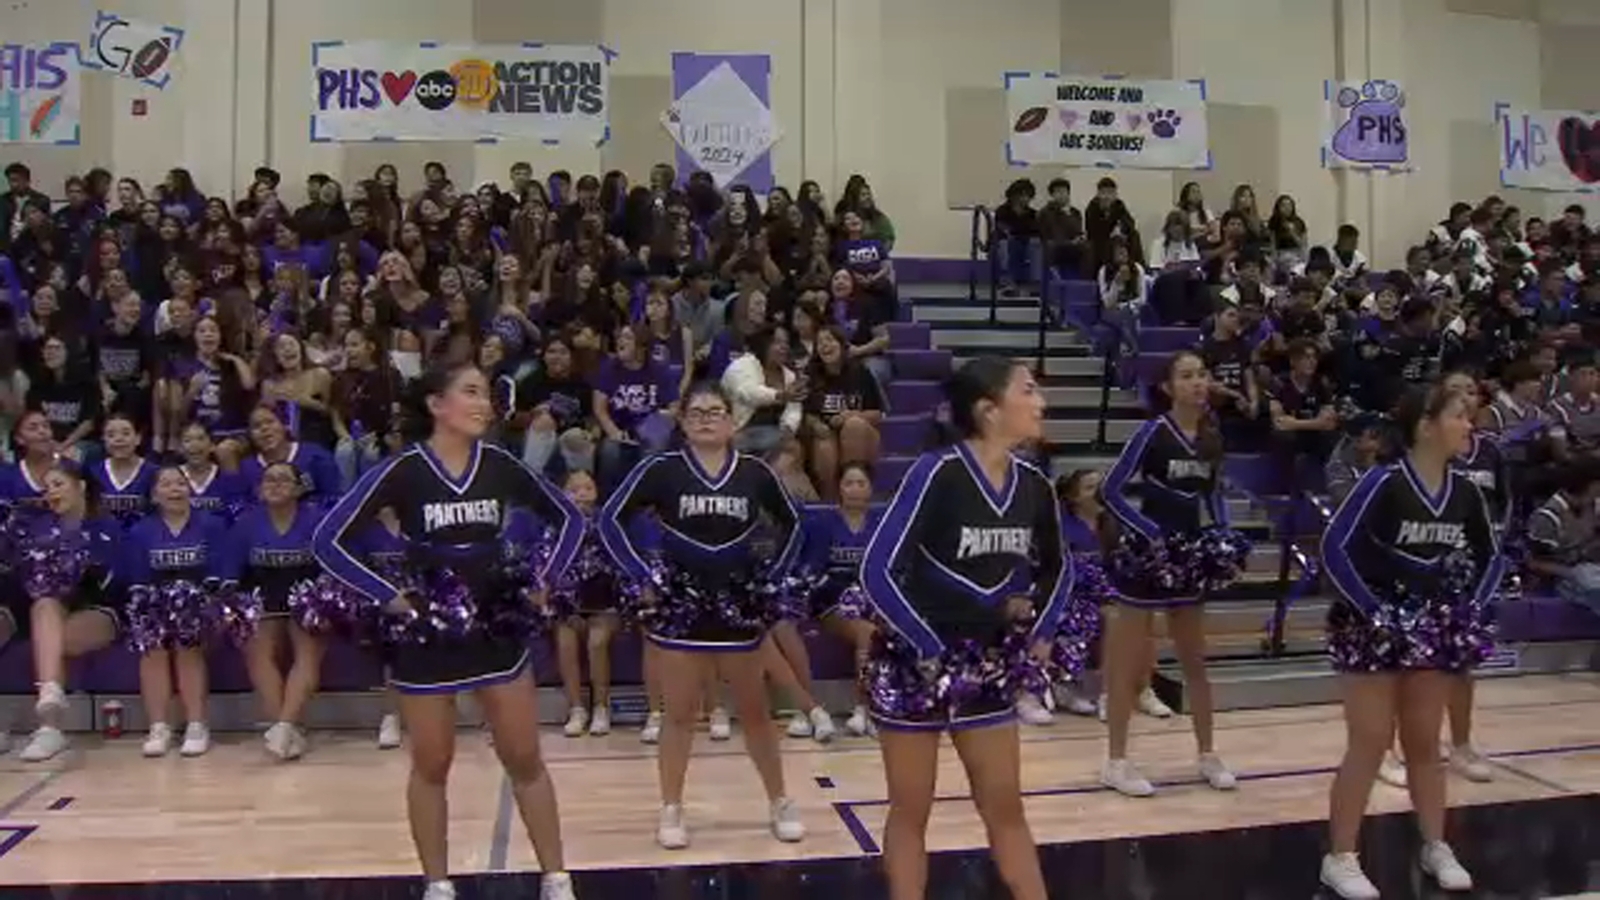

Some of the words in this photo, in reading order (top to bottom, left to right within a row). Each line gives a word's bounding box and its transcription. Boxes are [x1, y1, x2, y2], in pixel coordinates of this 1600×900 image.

[492, 61, 601, 85] ACTION
[318, 69, 381, 110] PHS
[416, 78, 454, 97] abc
[489, 85, 604, 113] NEWS
[1057, 85, 1116, 101] WELCOME
[1088, 109, 1115, 126] AND
[1357, 115, 1405, 144] PHS
[1059, 132, 1085, 149] ABC
[1503, 113, 1558, 171] We
[699, 146, 745, 167] 2024
[423, 499, 500, 532] PANTHERS
[679, 494, 750, 521] PANTHERS
